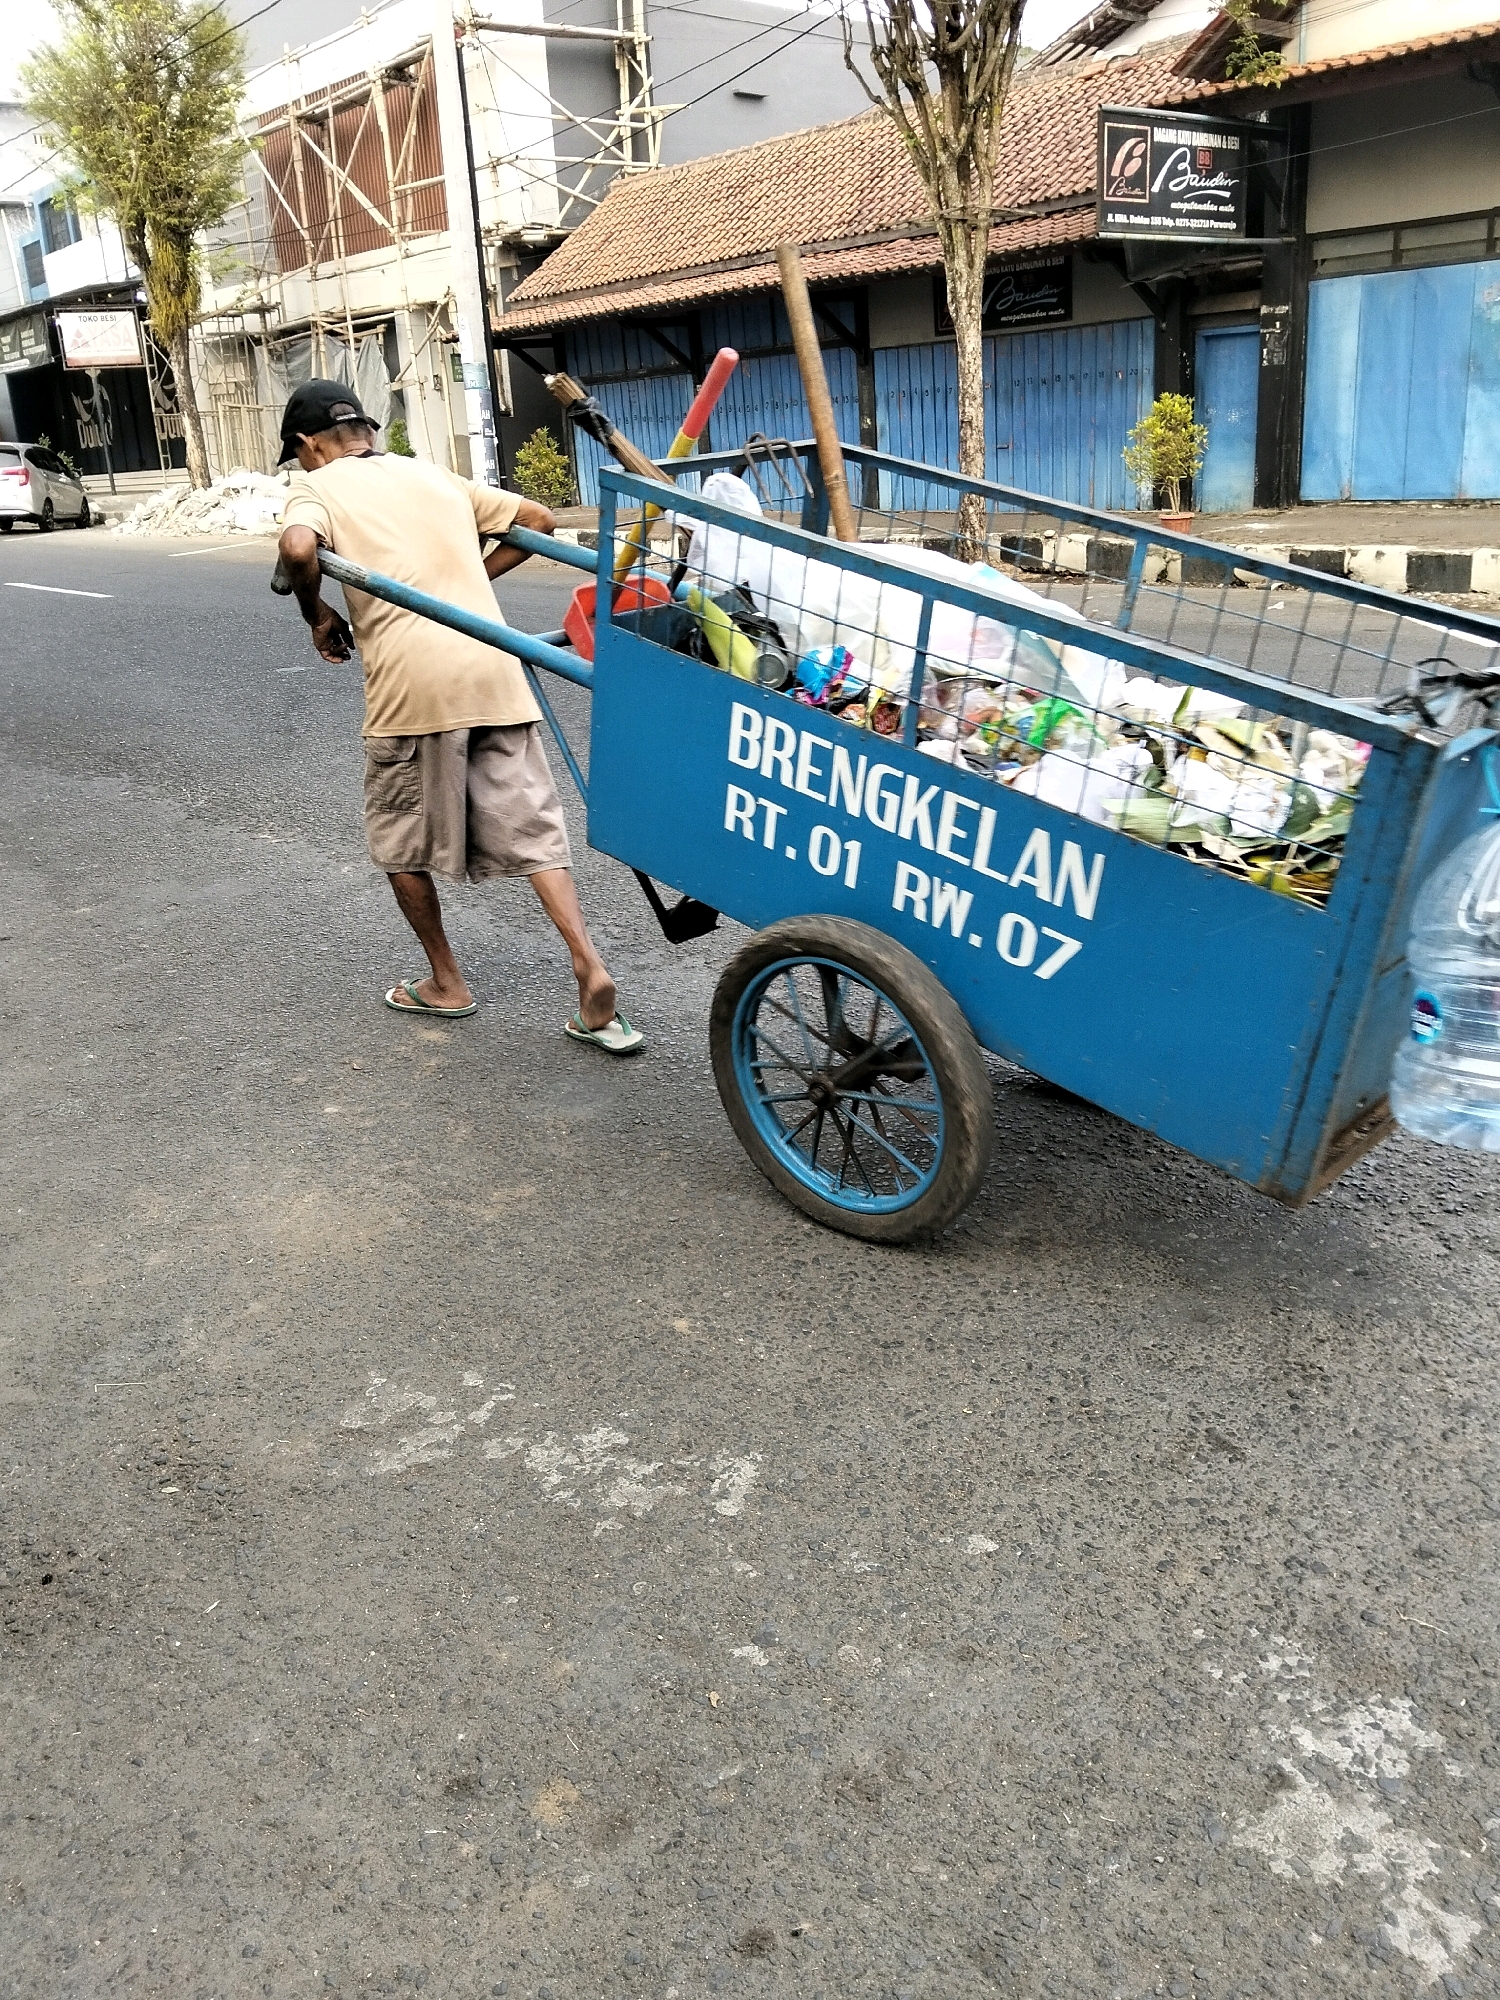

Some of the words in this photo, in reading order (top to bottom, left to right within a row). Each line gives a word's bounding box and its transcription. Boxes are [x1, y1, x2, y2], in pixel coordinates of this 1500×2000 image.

[1153, 126, 1177, 144] DAGANG
[1177, 129, 1192, 146] KAYU
[1191, 131, 1222, 148] BANGUNAN
[1221, 135, 1227, 149] &
[1227, 136, 1240, 150] BESI
[77, 315, 99, 323] TOKO
[99, 314, 117, 322] BESI
[86, 324, 135, 348] YASA
[727, 701, 1107, 921] BRENGKELAN
